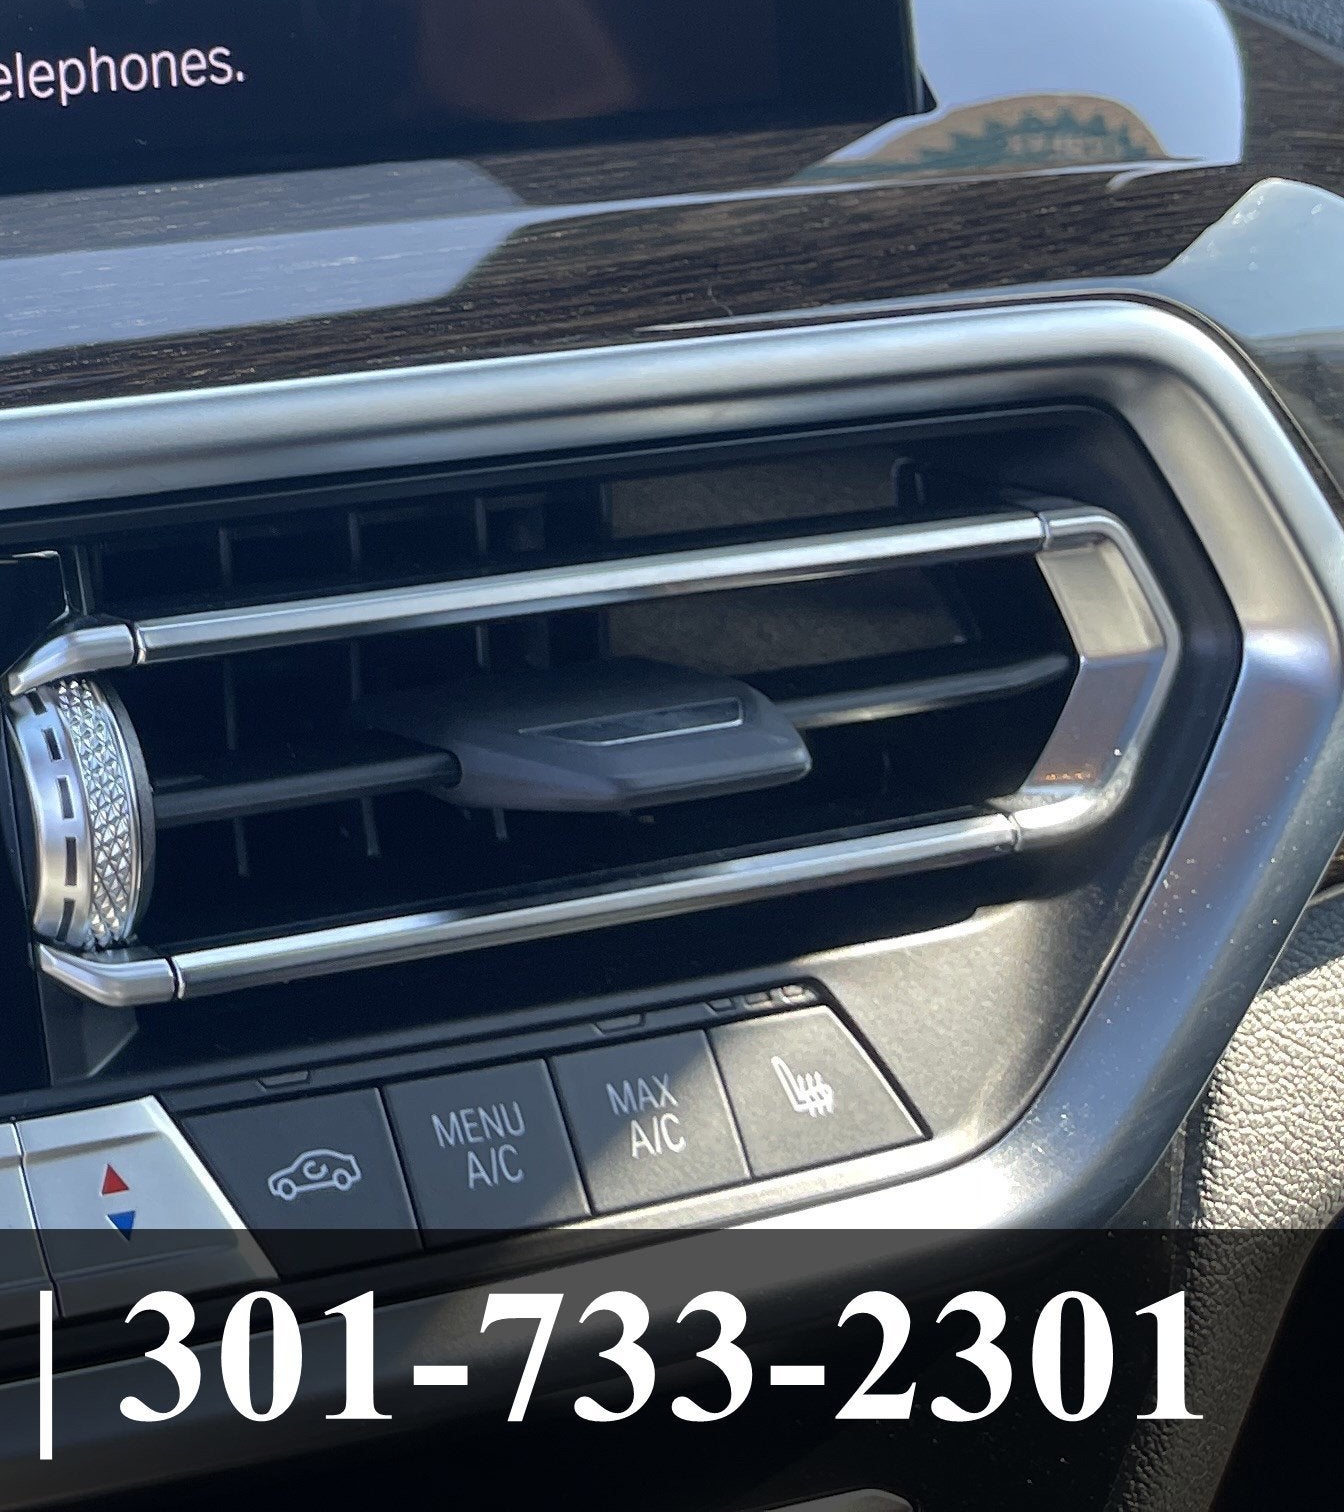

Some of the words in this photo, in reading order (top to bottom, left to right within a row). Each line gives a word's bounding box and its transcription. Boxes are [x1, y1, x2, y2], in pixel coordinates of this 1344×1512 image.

[606, 1072, 679, 1117] MAX
[430, 1100, 526, 1149] MENU
[630, 1112, 687, 1159] A/C
[467, 1143, 524, 1190] A/C
